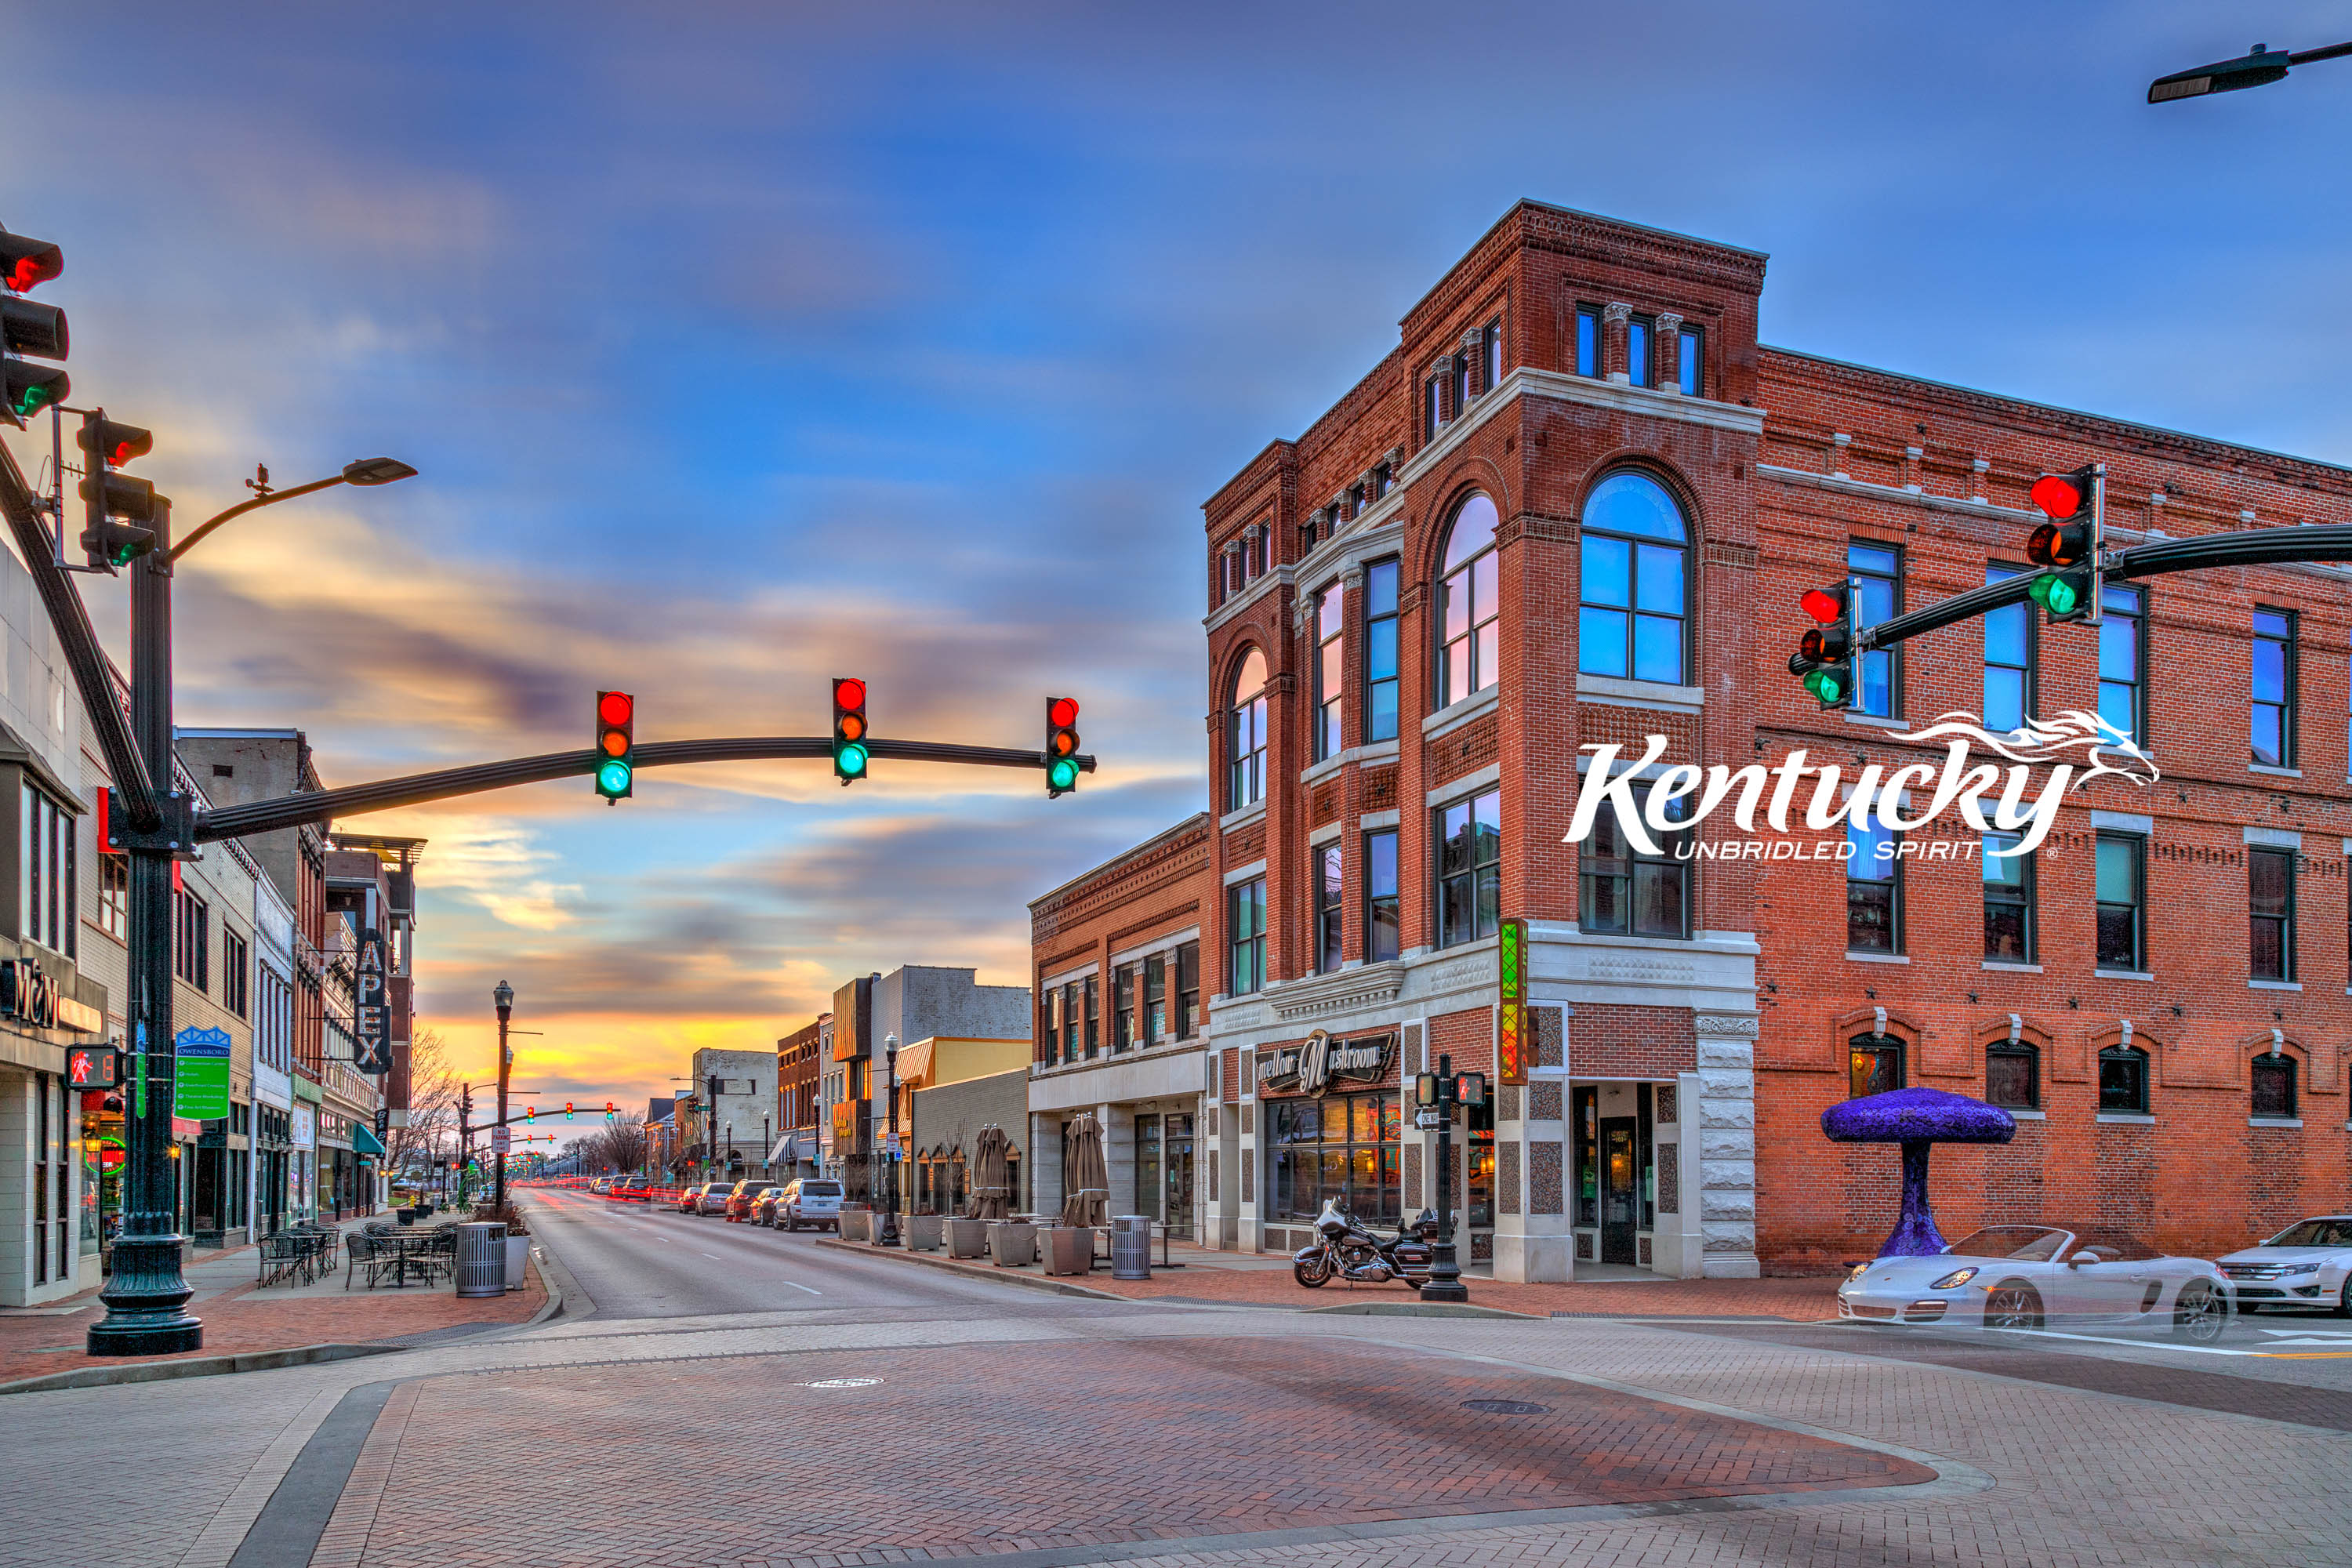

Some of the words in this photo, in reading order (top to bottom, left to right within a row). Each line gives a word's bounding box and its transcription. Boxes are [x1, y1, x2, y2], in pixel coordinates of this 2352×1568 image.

[357, 941, 382, 1065] APEX
[1258, 1048, 1297, 1081] mellow
[1298, 1037, 1380, 1092] Mushroom
